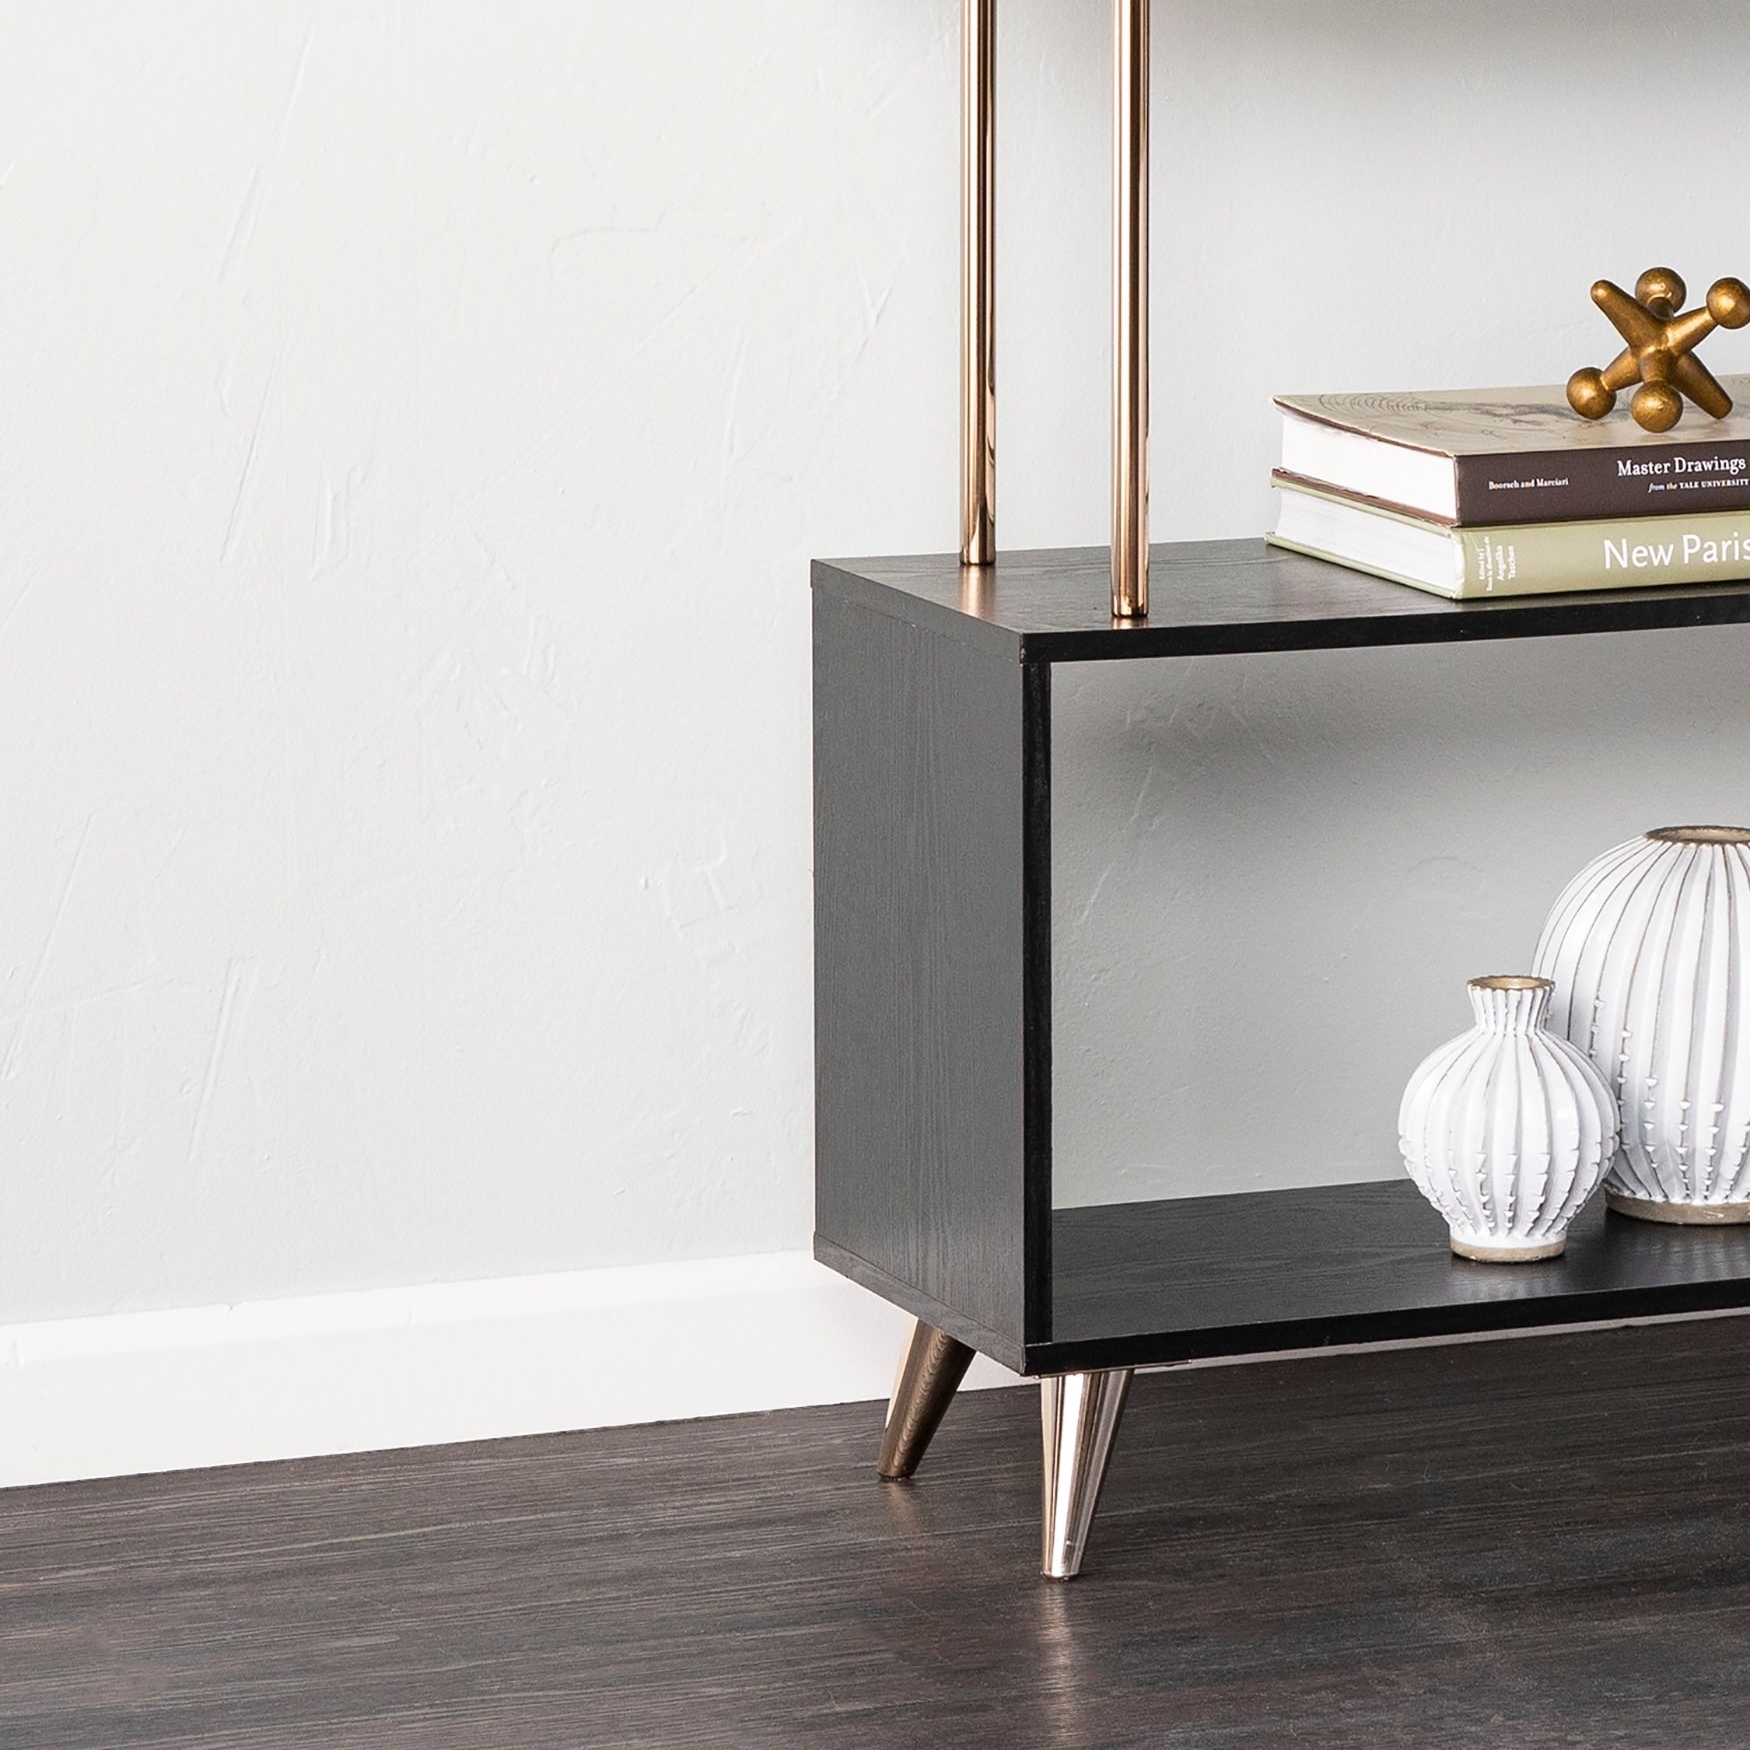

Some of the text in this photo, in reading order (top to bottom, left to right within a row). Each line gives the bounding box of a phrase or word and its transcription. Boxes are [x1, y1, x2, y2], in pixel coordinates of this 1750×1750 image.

[1617, 456, 1746, 477] Master Drawings
[1488, 480, 1519, 490] Boorsch
[1520, 479, 1535, 489] and
[1648, 483, 1665, 493] from
[1666, 482, 1678, 491] the
[1679, 481, 1699, 490] YALE
[1701, 478, 1750, 488] UNIVERSITY
[1495, 545, 1507, 581] Angelika
[1507, 545, 1516, 580] Taschen
[1603, 538, 1674, 569] New
